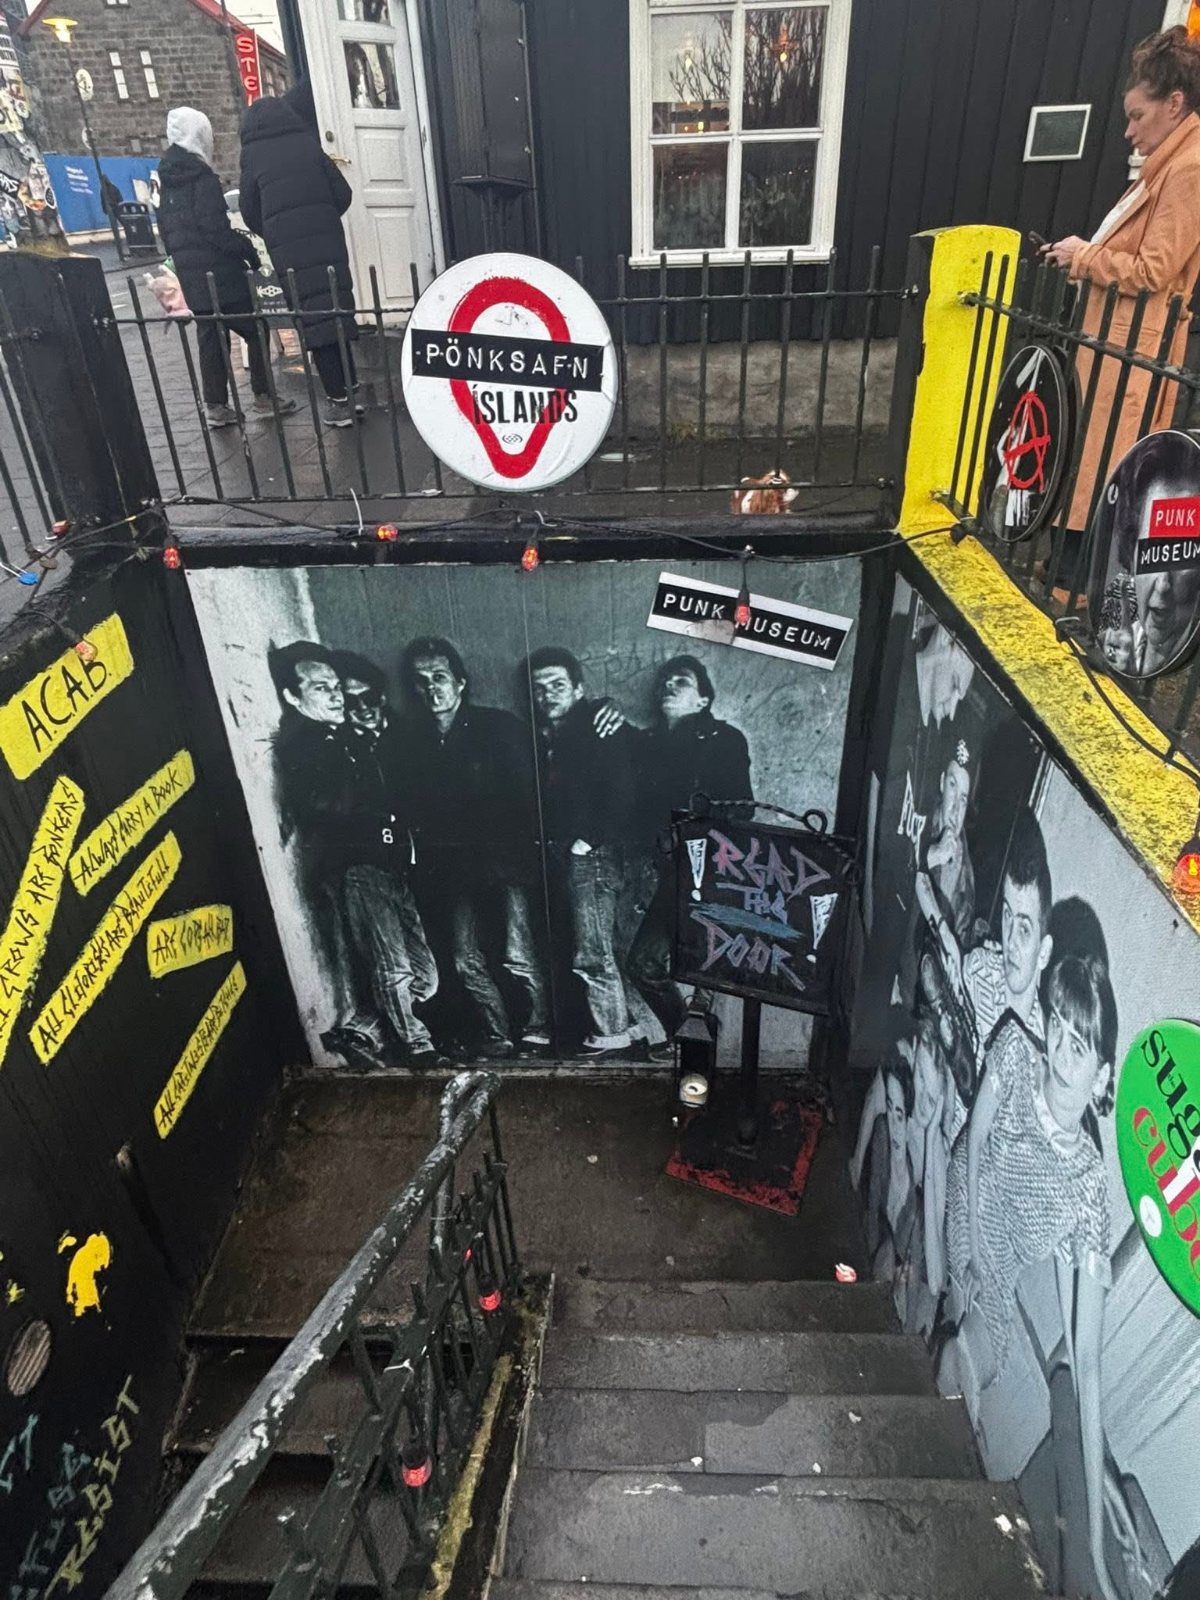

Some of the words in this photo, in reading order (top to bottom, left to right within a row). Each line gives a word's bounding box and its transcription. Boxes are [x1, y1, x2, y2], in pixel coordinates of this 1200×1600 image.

[425, 337, 589, 380] PÖNKSAFN
[471, 384, 578, 424] ÍSLANDS
[1155, 508, 1196, 527] PUNK
[1140, 540, 1200, 565] MUSEUM
[662, 593, 727, 619] PUNK
[142, 797, 157, 817] A
